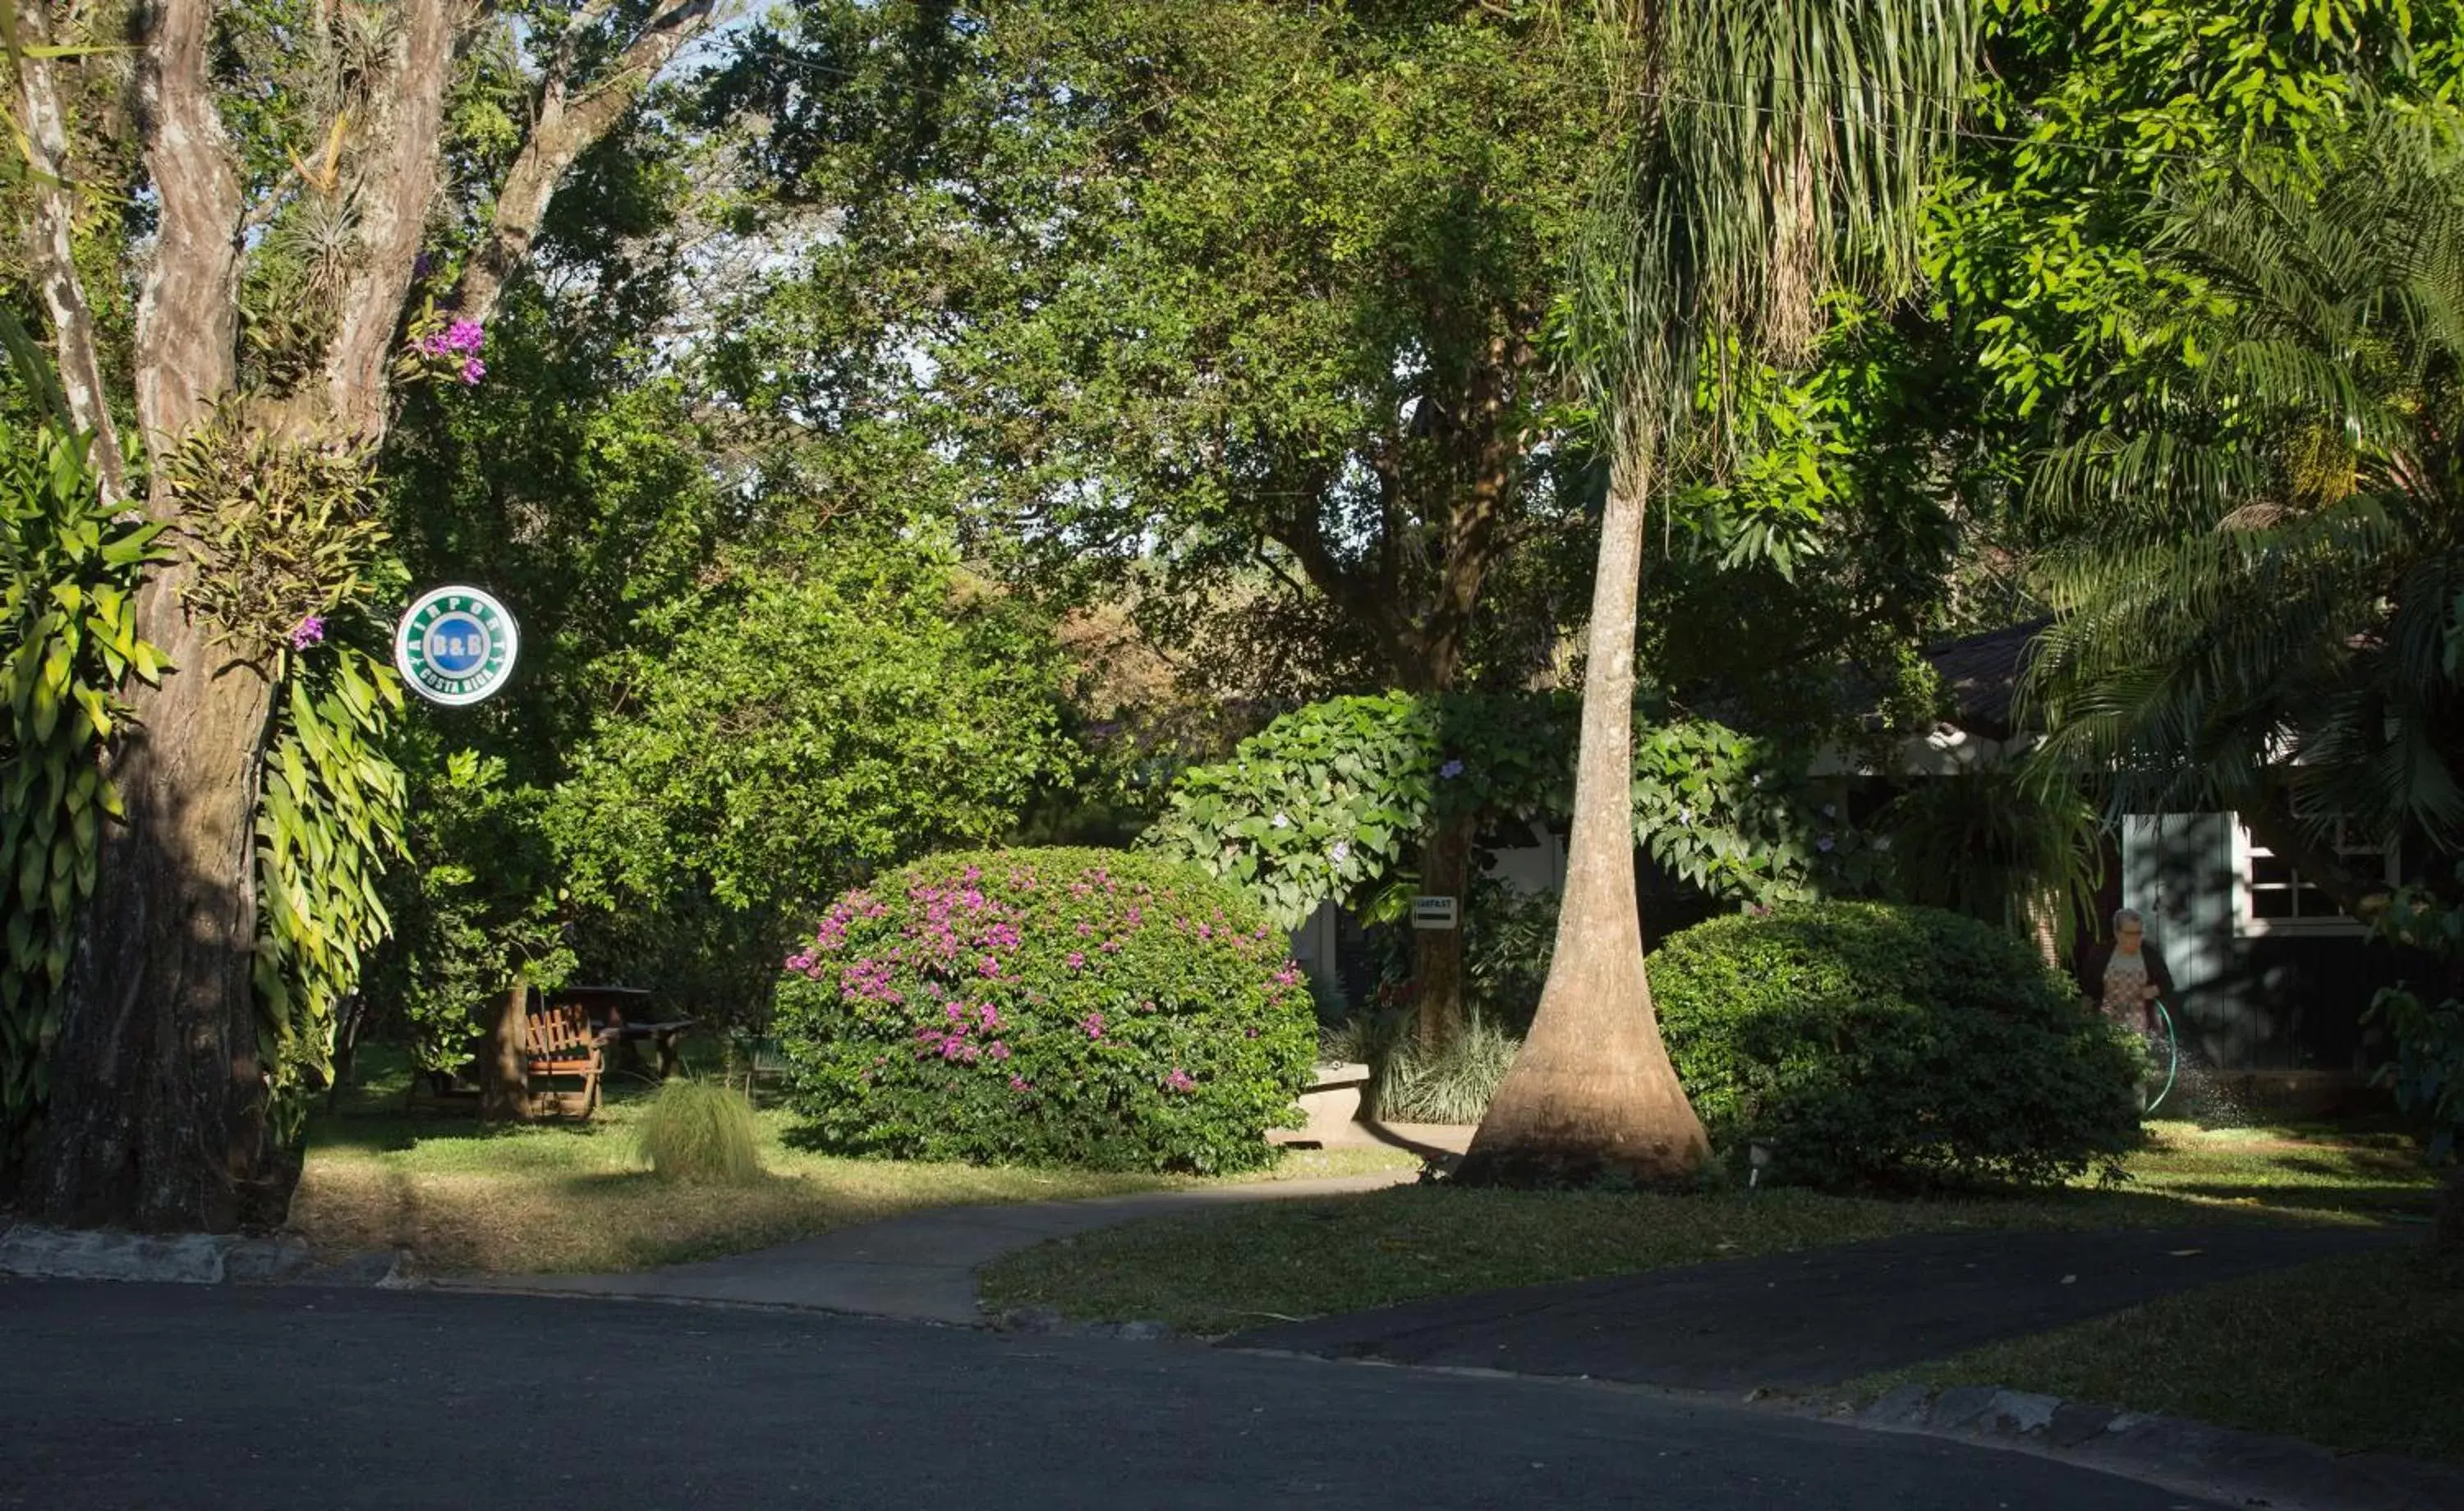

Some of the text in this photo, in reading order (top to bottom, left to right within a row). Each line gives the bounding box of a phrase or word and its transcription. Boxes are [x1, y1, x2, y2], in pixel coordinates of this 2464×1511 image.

[408, 598, 505, 652] AIRPORT
[433, 634, 482, 656] B&B
[420, 667, 494, 693] COSTA RICA
